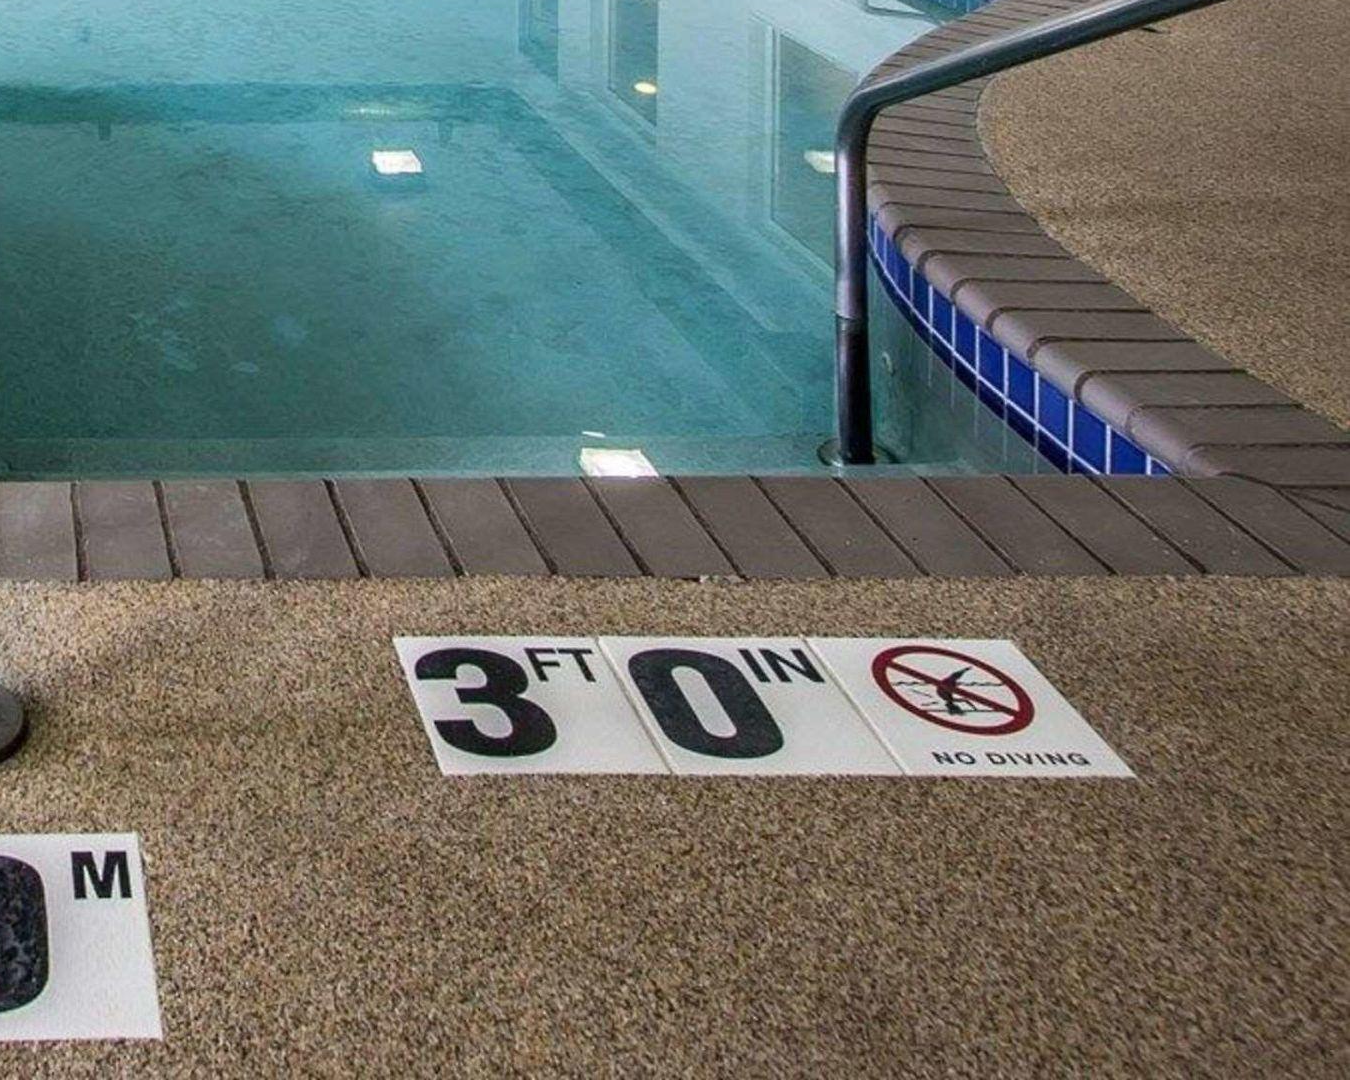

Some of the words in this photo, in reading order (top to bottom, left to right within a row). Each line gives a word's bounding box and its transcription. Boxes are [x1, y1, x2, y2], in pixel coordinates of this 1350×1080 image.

[414, 647, 557, 758] 3
[523, 647, 597, 683] FT
[628, 647, 784, 759] 0
[737, 647, 825, 684] IN
[931, 751, 977, 766] NO
[984, 751, 1092, 766] DIVING
[70, 850, 132, 900] M
